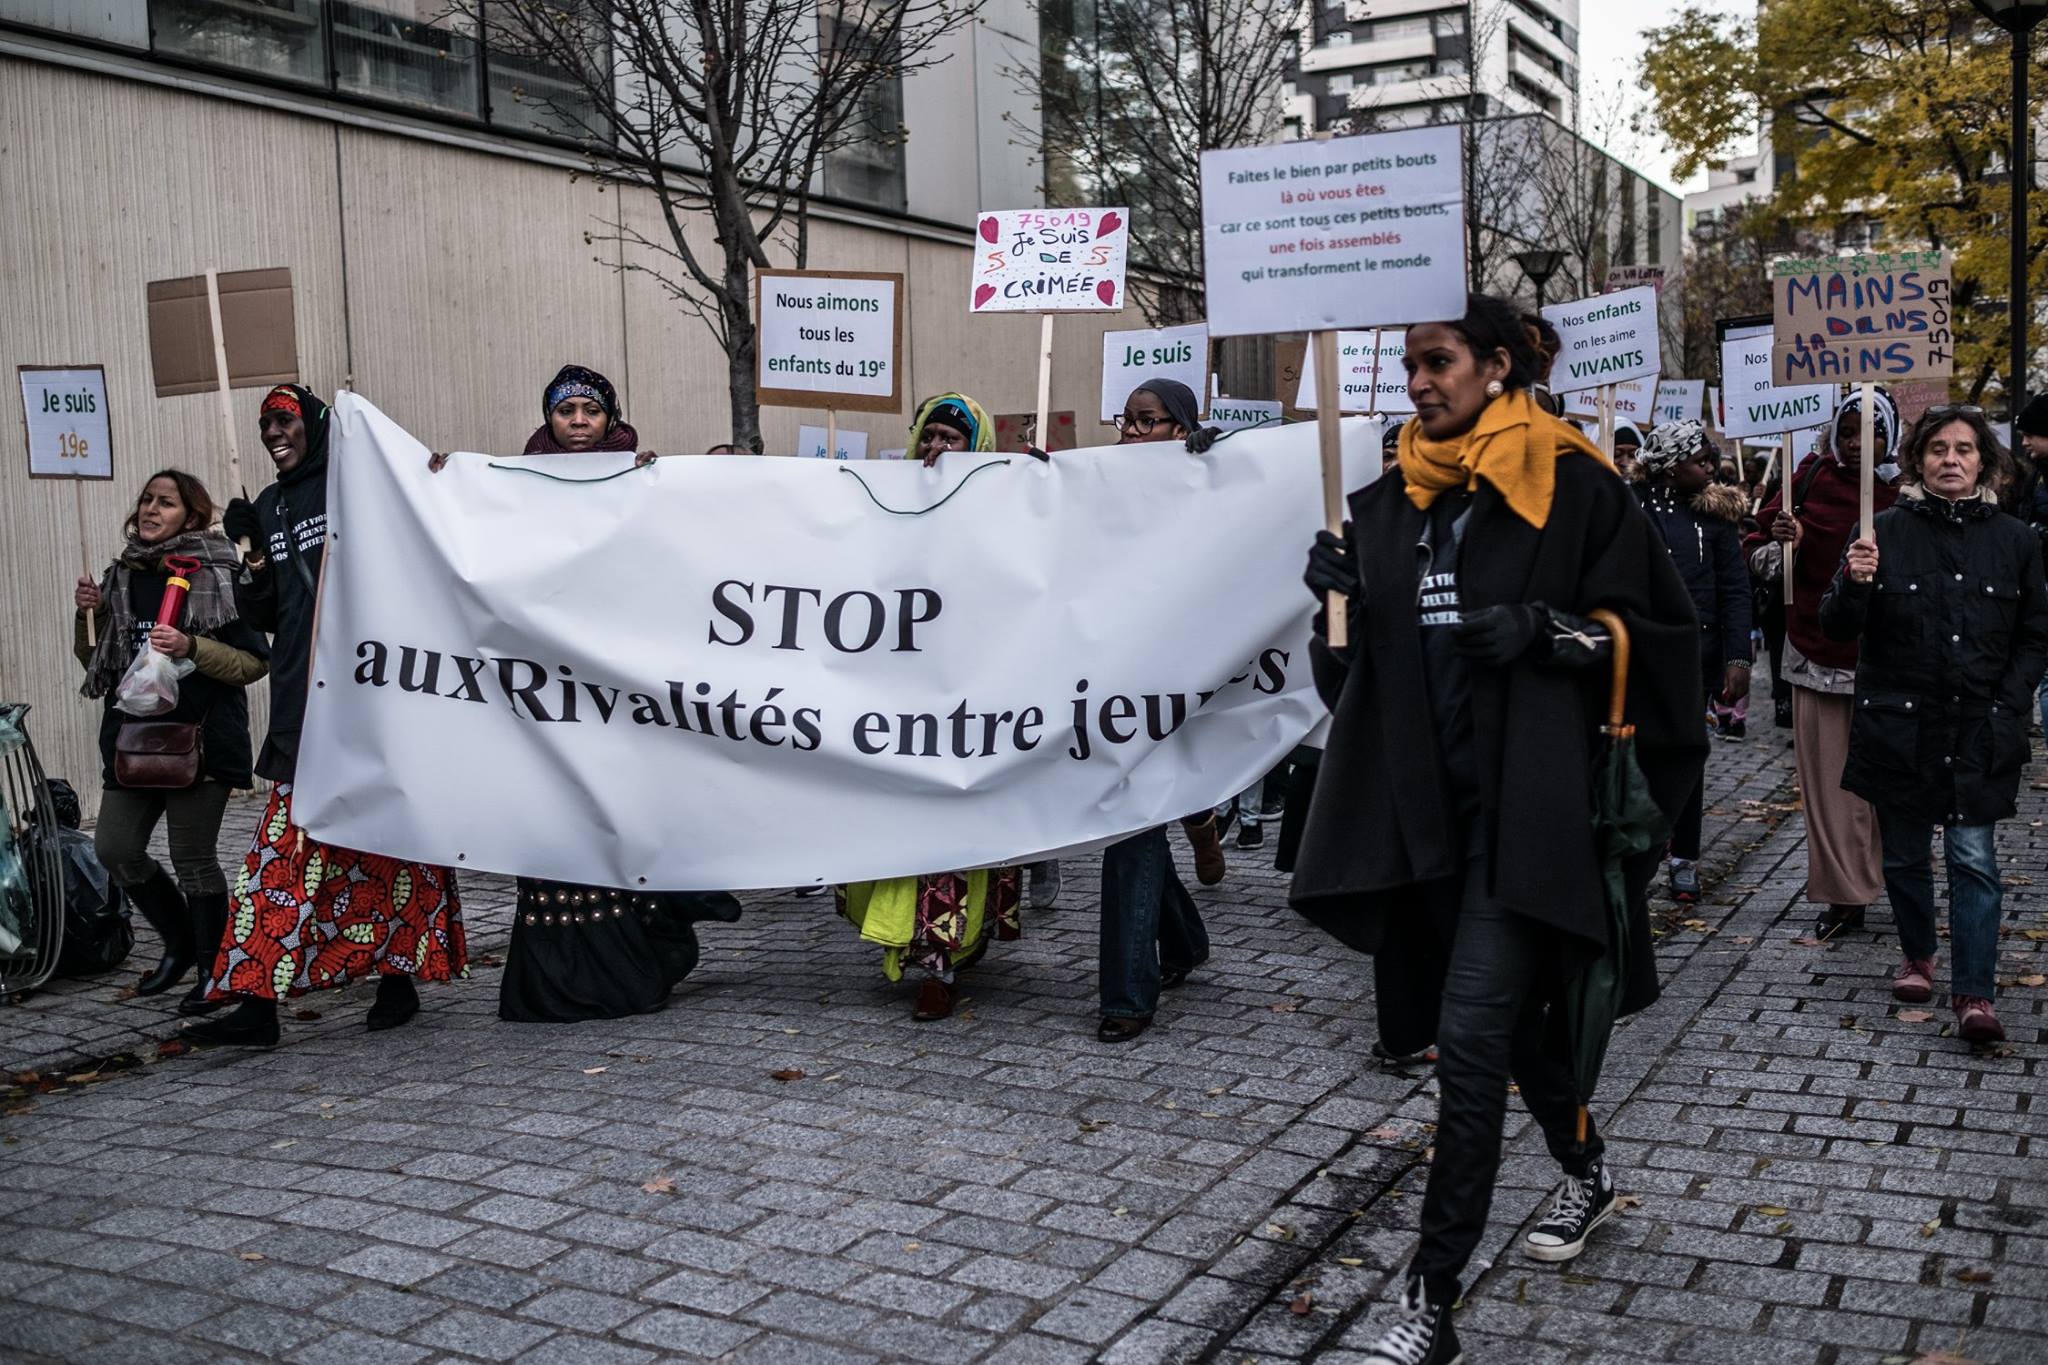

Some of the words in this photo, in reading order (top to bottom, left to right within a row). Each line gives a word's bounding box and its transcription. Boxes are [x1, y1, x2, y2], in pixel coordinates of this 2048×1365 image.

[1228, 170, 1270, 184] Faites
[1274, 167, 1287, 180] le
[1290, 164, 1321, 178] bien
[1325, 162, 1348, 178] par
[1352, 156, 1392, 175] petits
[1396, 153, 1437, 168] bouts
[1280, 190, 1293, 204] là
[1297, 188, 1315, 202] où
[1319, 187, 1352, 200] vous
[1356, 184, 1386, 197] êtes
[1018, 212, 1092, 229] 75019
[1220, 222, 1242, 234] car
[1246, 221, 1262, 232] ce
[1265, 217, 1296, 230] sont
[1300, 214, 1330, 227] tous
[1334, 213, 1356, 224] ces
[1360, 206, 1400, 224] petits
[1404, 203, 1449, 217] bouts,
[1012, 232, 1036, 257] Je
[1270, 243, 1296, 254] une
[1300, 238, 1325, 251] fois
[1328, 231, 1402, 249] assemblés
[1040, 251, 1072, 264] DE
[1241, 266, 1264, 282] qui
[1268, 260, 1361, 279] transforment
[1364, 258, 1378, 271] le
[1381, 253, 1432, 269] monde
[776, 293, 813, 309] Nous
[817, 292, 879, 312] aimons
[1562, 315, 1584, 328] Nos
[1587, 300, 1641, 322] enfants
[1927, 279, 1953, 366] 75019
[800, 326, 830, 341] tous
[835, 327, 855, 342] les
[1573, 338, 1588, 350] on
[1591, 335, 1606, 346] les
[1609, 329, 1636, 343] aime
[1123, 346, 1146, 367] Je
[1152, 340, 1192, 365] suis
[1342, 346, 1358, 356] de
[1745, 353, 1768, 366] Nos
[768, 354, 832, 375] enfants
[836, 361, 854, 376] du
[858, 360, 886, 378] 19e
[1569, 350, 1644, 378] VIVANTS
[1344, 382, 1407, 394] quatiers
[1680, 386, 1688, 395] la
[1754, 380, 1770, 391] on
[42, 388, 60, 413] Je
[64, 387, 96, 413] suis
[1748, 394, 1820, 422] VIVANTS
[1210, 408, 1270, 422] NFANTS
[59, 432, 88, 458] 19e
[816, 445, 827, 459] Je
[708, 579, 943, 653] STOP
[852, 698, 1044, 759] entre
[1067, 648, 1291, 762] jeus
